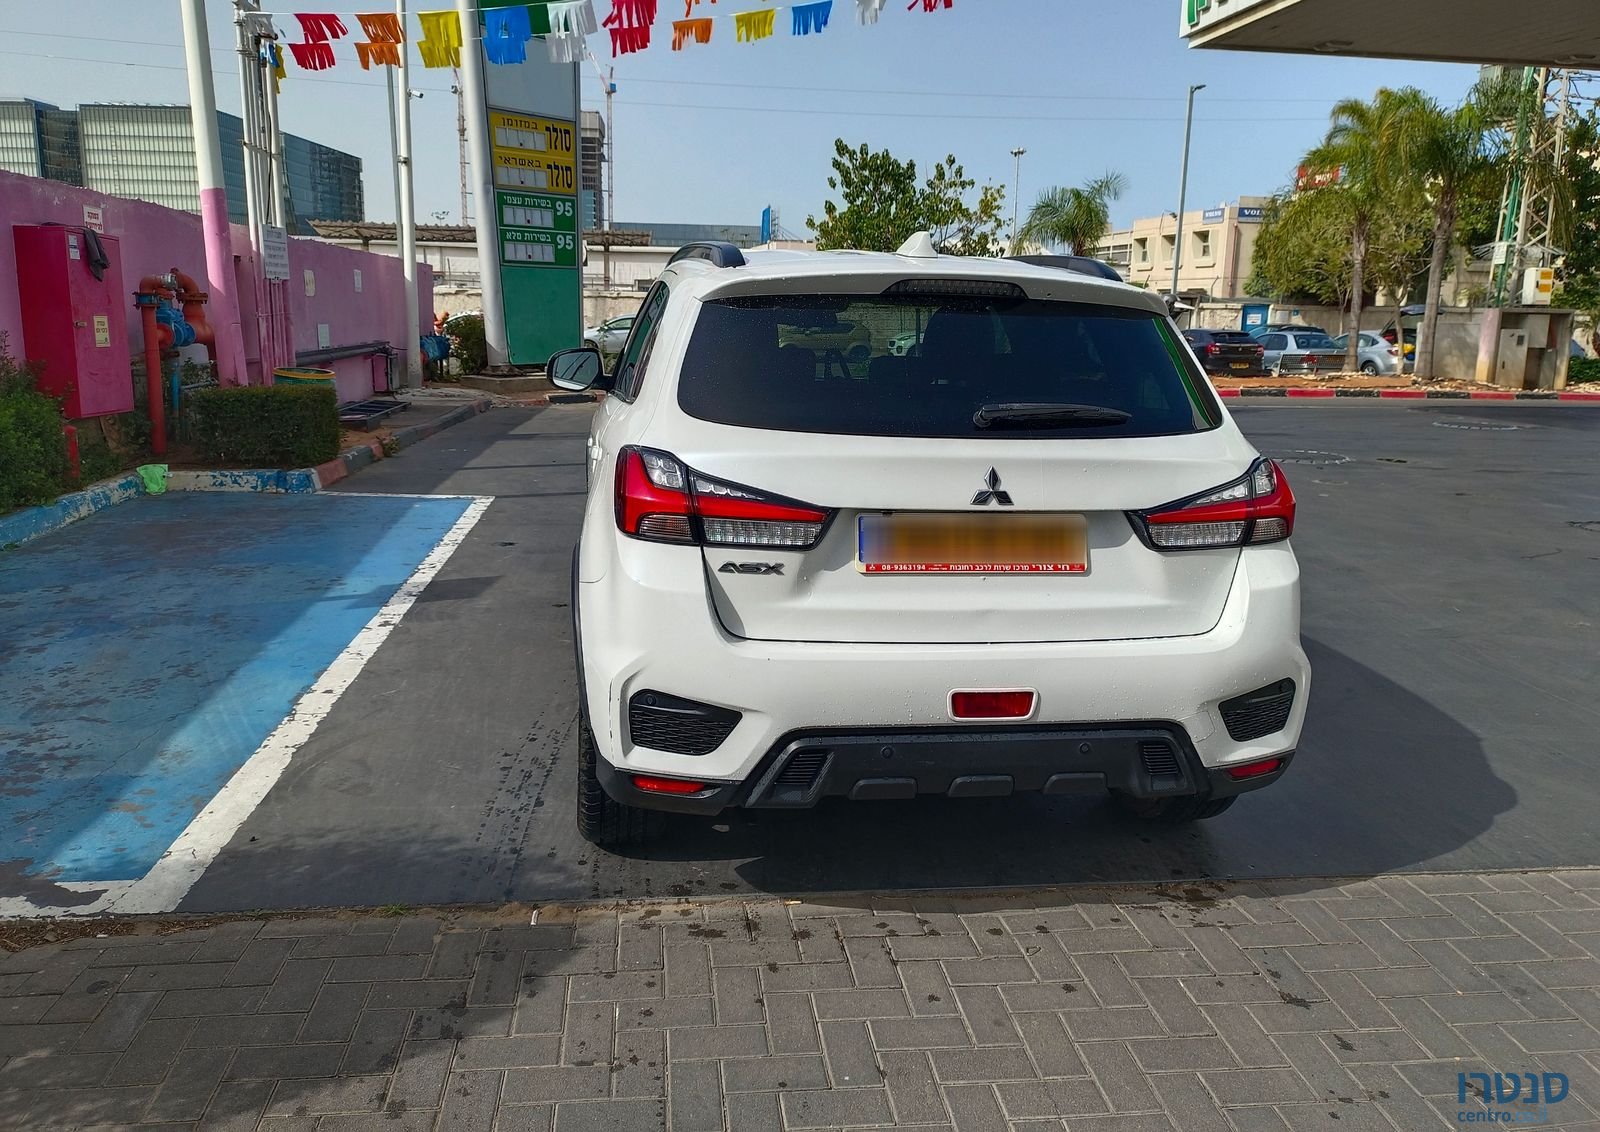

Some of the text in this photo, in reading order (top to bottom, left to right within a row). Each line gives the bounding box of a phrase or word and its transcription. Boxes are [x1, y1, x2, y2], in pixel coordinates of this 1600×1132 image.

[502, 117, 538, 130] במזומן
[545, 124, 571, 152] סולר
[499, 156, 541, 168] באשראי
[547, 161, 572, 188] סולר
[504, 196, 552, 207] בשירות עצמי
[555, 201, 573, 216] 95
[506, 231, 551, 242] בשירות מלא
[556, 235, 574, 249] 95
[718, 561, 785, 576] ASX
[975, 563, 992, 571] לרכב
